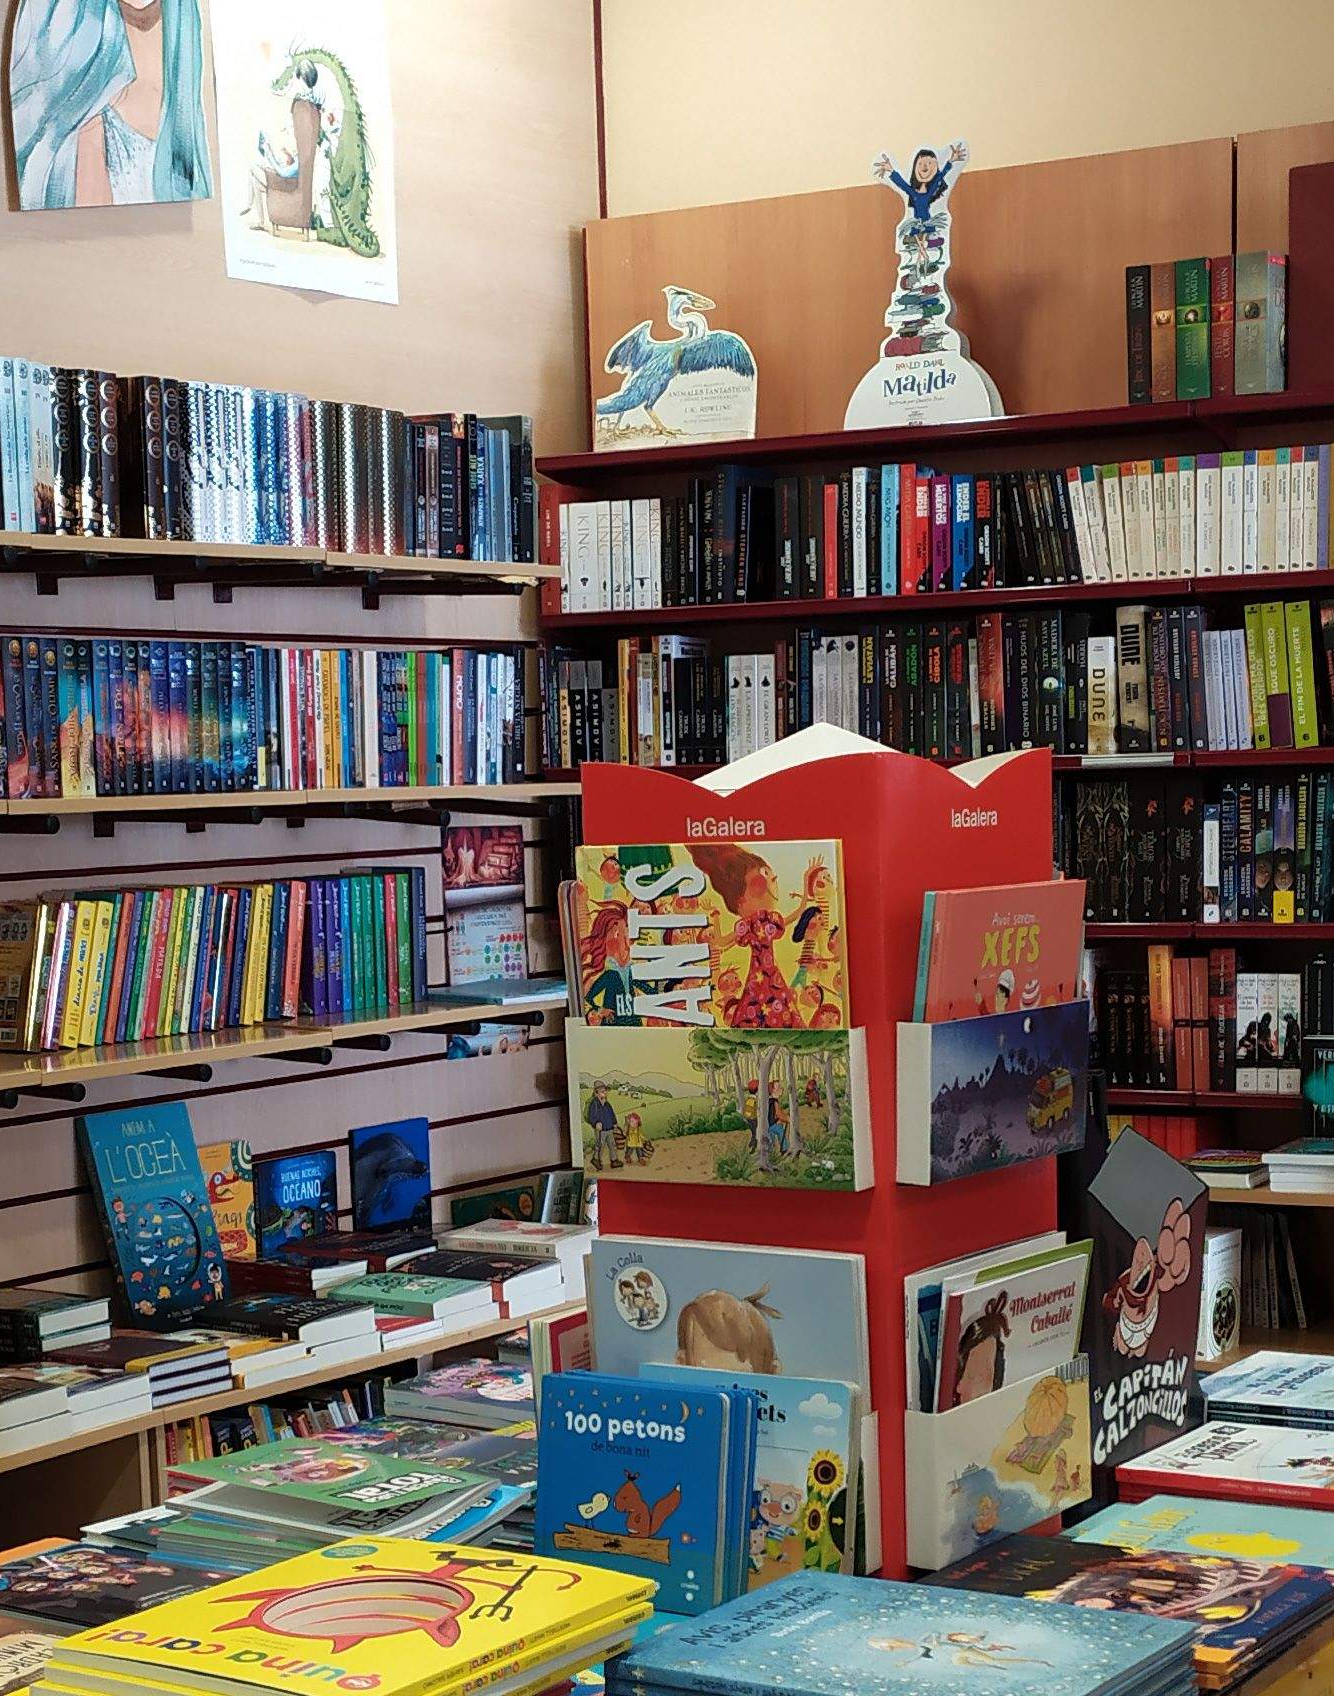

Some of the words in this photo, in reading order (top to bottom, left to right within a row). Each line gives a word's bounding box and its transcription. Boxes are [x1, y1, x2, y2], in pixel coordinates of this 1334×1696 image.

[883, 370, 957, 398] Matilda
[1120, 625, 1141, 667] DUNE
[686, 816, 766, 839] laGalera
[950, 808, 998, 828] laGalera
[1239, 793, 1252, 853] CALAMITY
[981, 925, 1041, 970] XEFS
[148, 1120, 156, 1132] A
[105, 1131, 187, 1184] L'OCEÀ
[621, 1250, 645, 1270] Colla
[1009, 1281, 1077, 1318] Montserrat
[1029, 1302, 1074, 1335] Caballé
[1101, 1349, 1188, 1420] CAPITÁN
[564, 1410, 602, 1435] 100
[607, 1413, 687, 1443] petons
[1093, 1388, 1189, 1466] CALZONCILLOS
[590, 1439, 605, 1454] de
[633, 1445, 651, 1458] nit
